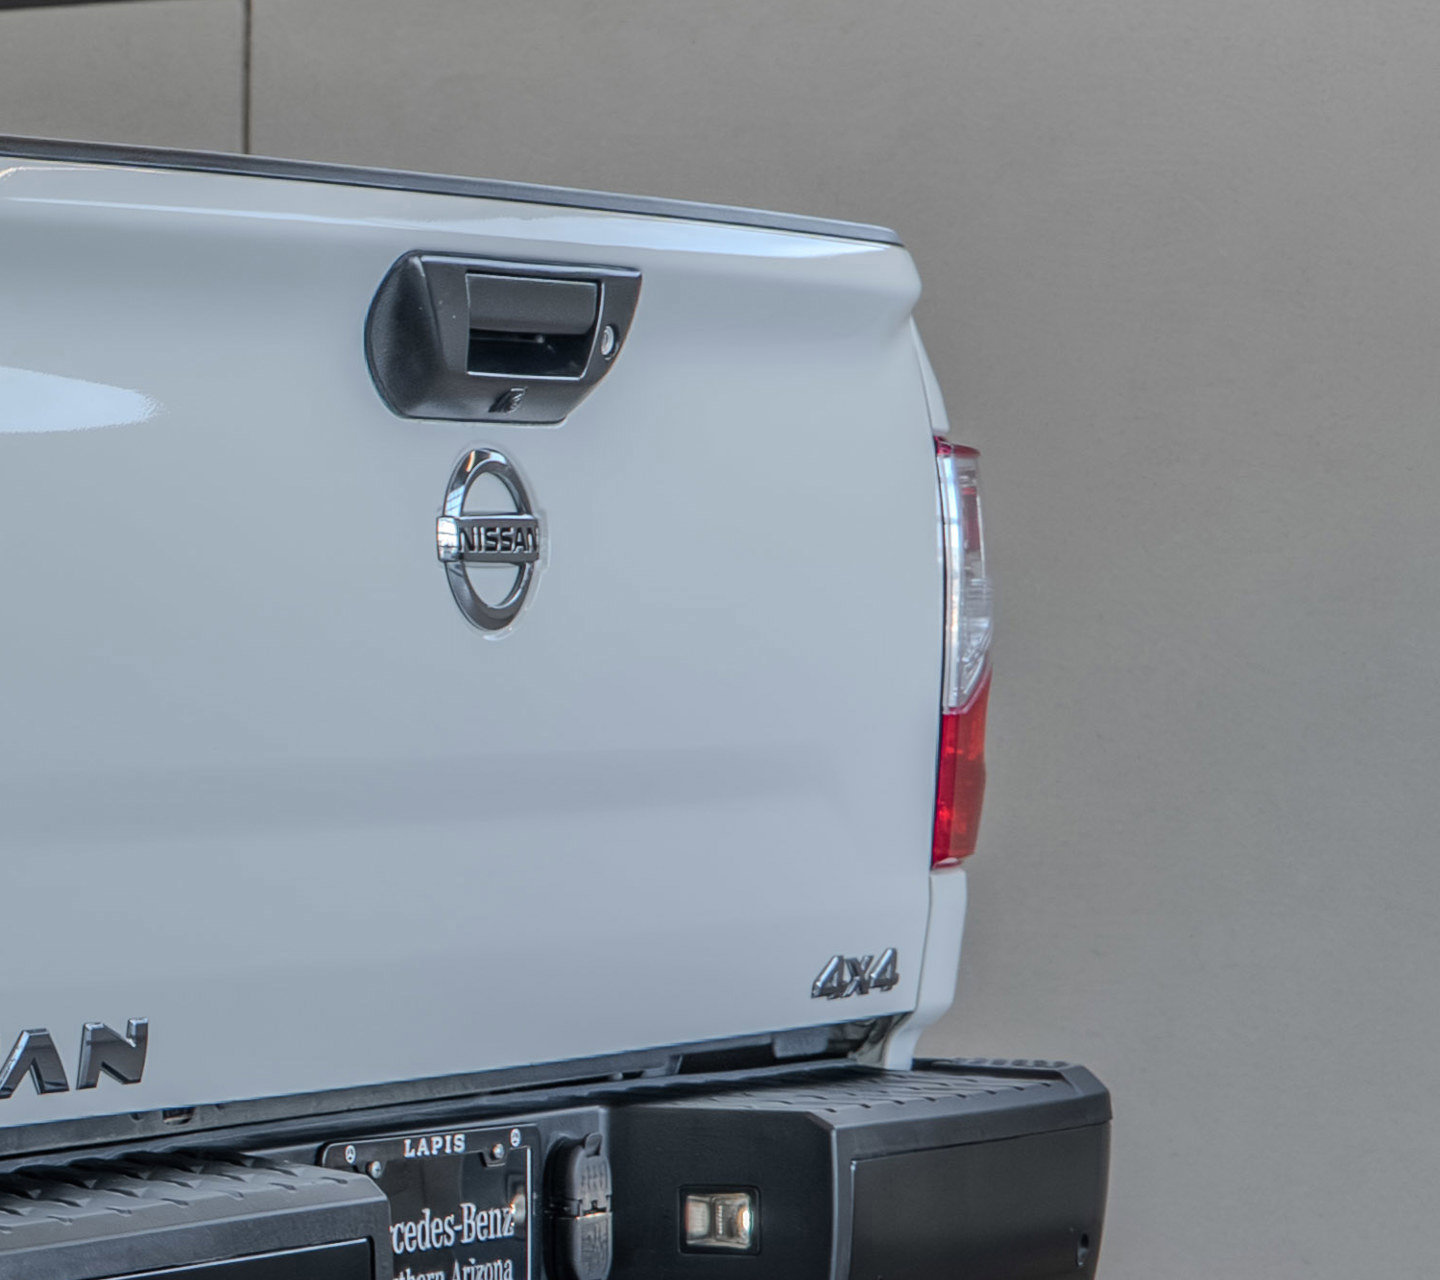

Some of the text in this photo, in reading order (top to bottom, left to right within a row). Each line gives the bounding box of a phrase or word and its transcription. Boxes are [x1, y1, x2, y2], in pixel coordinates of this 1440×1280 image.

[459, 526, 539, 554] NISSAN
[403, 1133, 467, 1158] LAPIS
[389, 1202, 515, 1255] cedes-Benz
